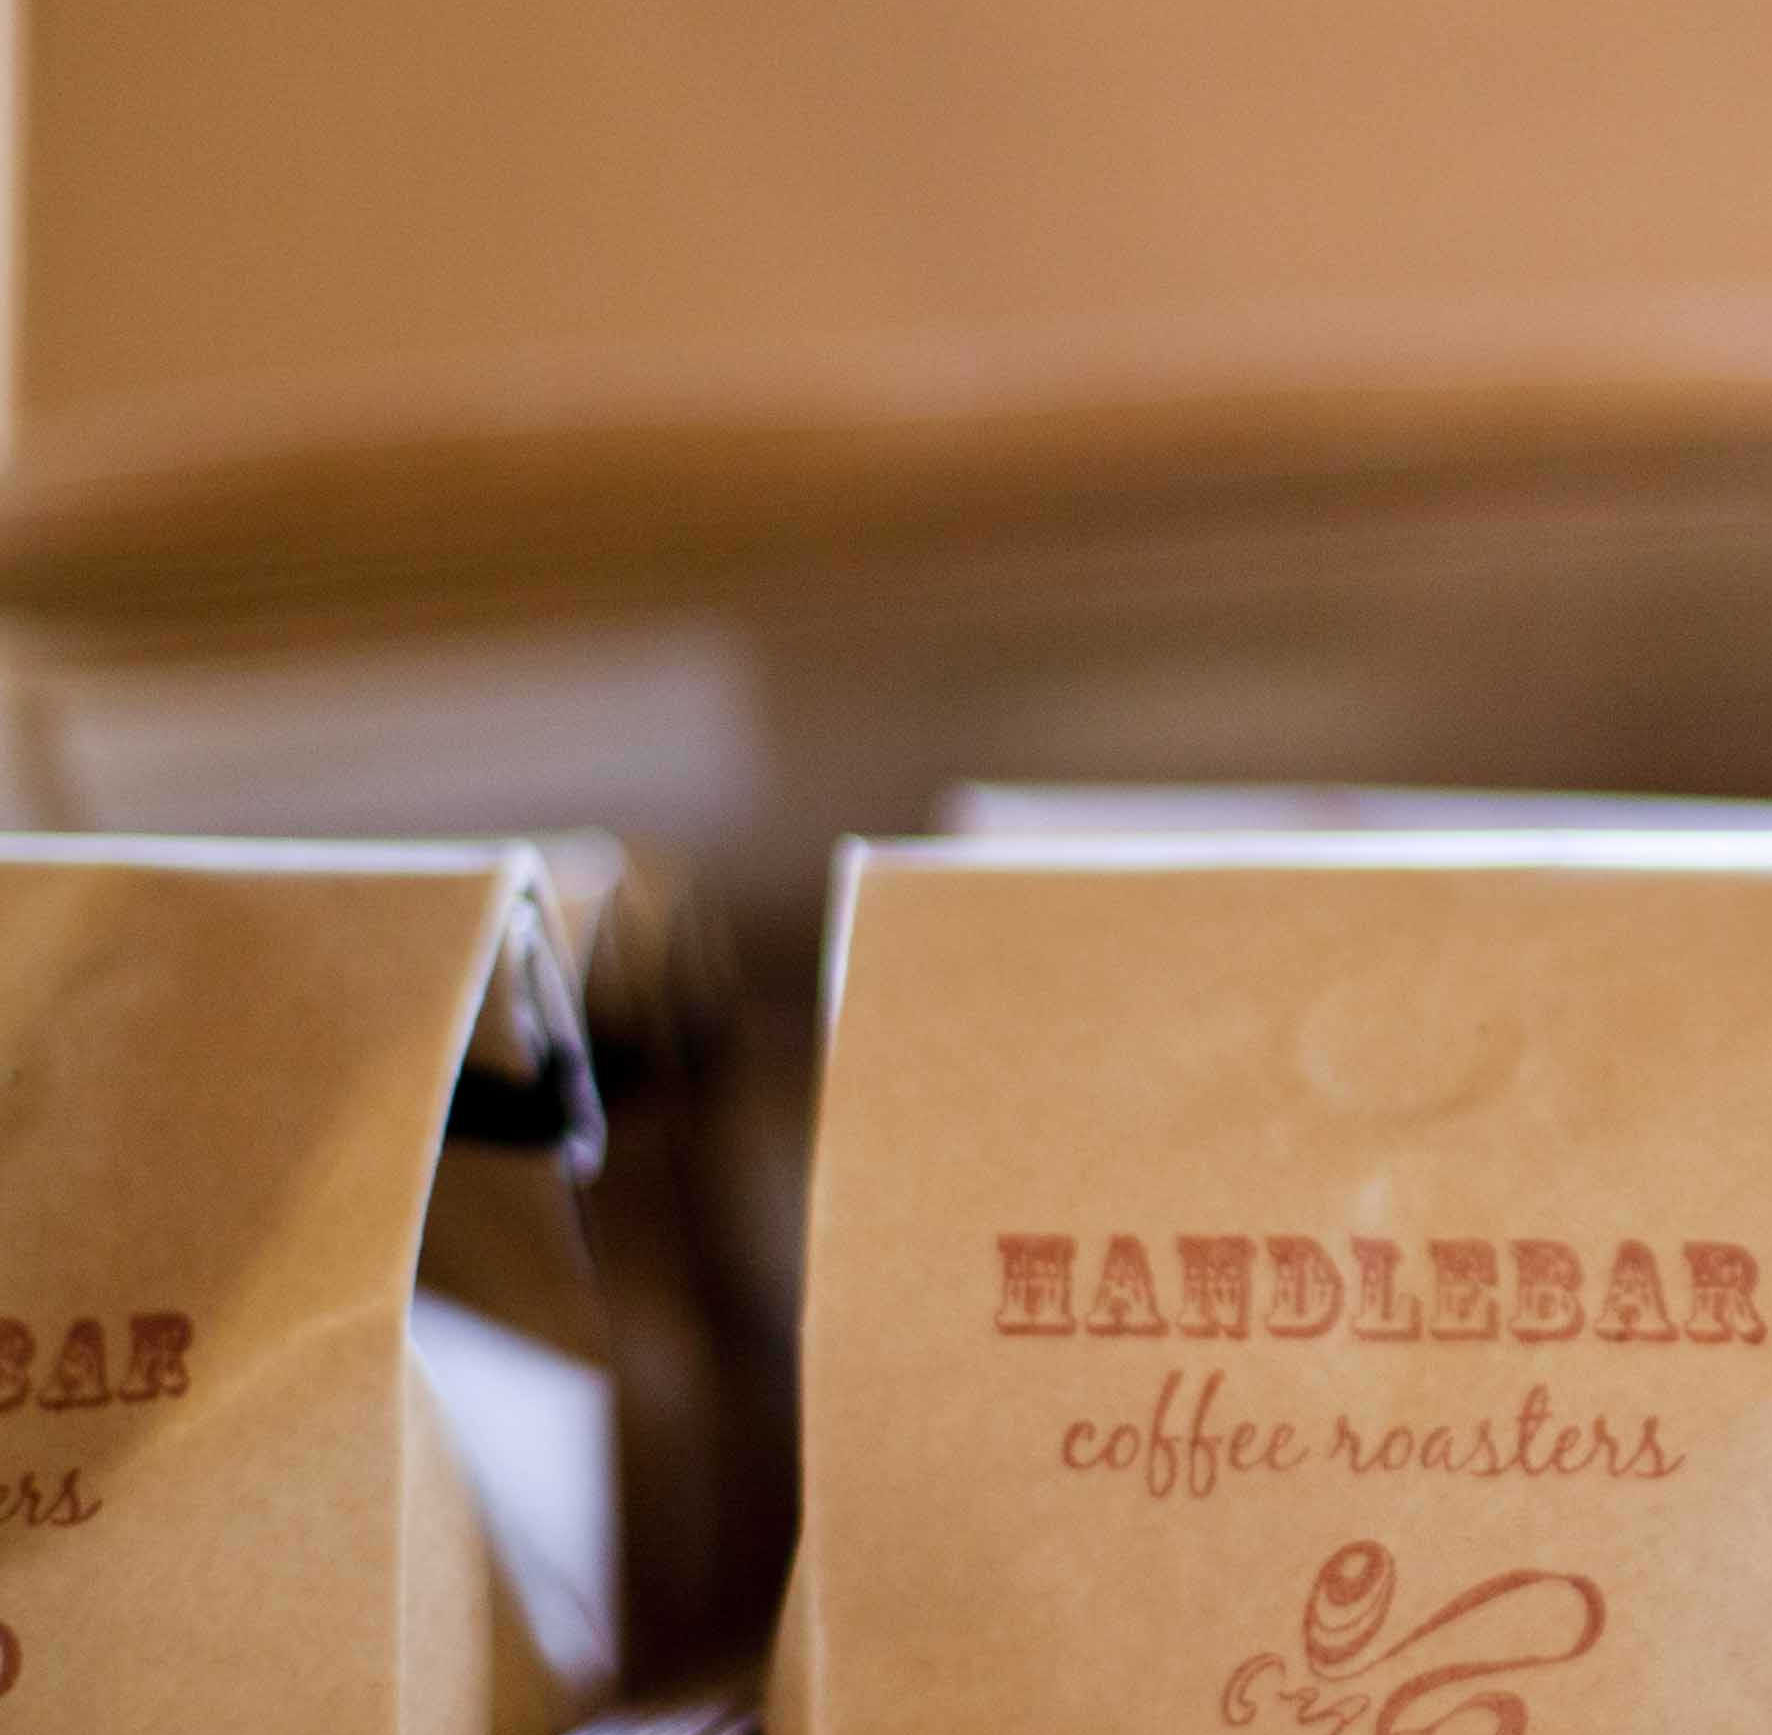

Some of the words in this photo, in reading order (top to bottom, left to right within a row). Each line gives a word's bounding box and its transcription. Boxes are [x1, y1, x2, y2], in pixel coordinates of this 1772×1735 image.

[994, 1232, 1768, 1346] HANDLEBAR
[1061, 1370, 1309, 1499] coffee
[1332, 1384, 1686, 1480] roasters
